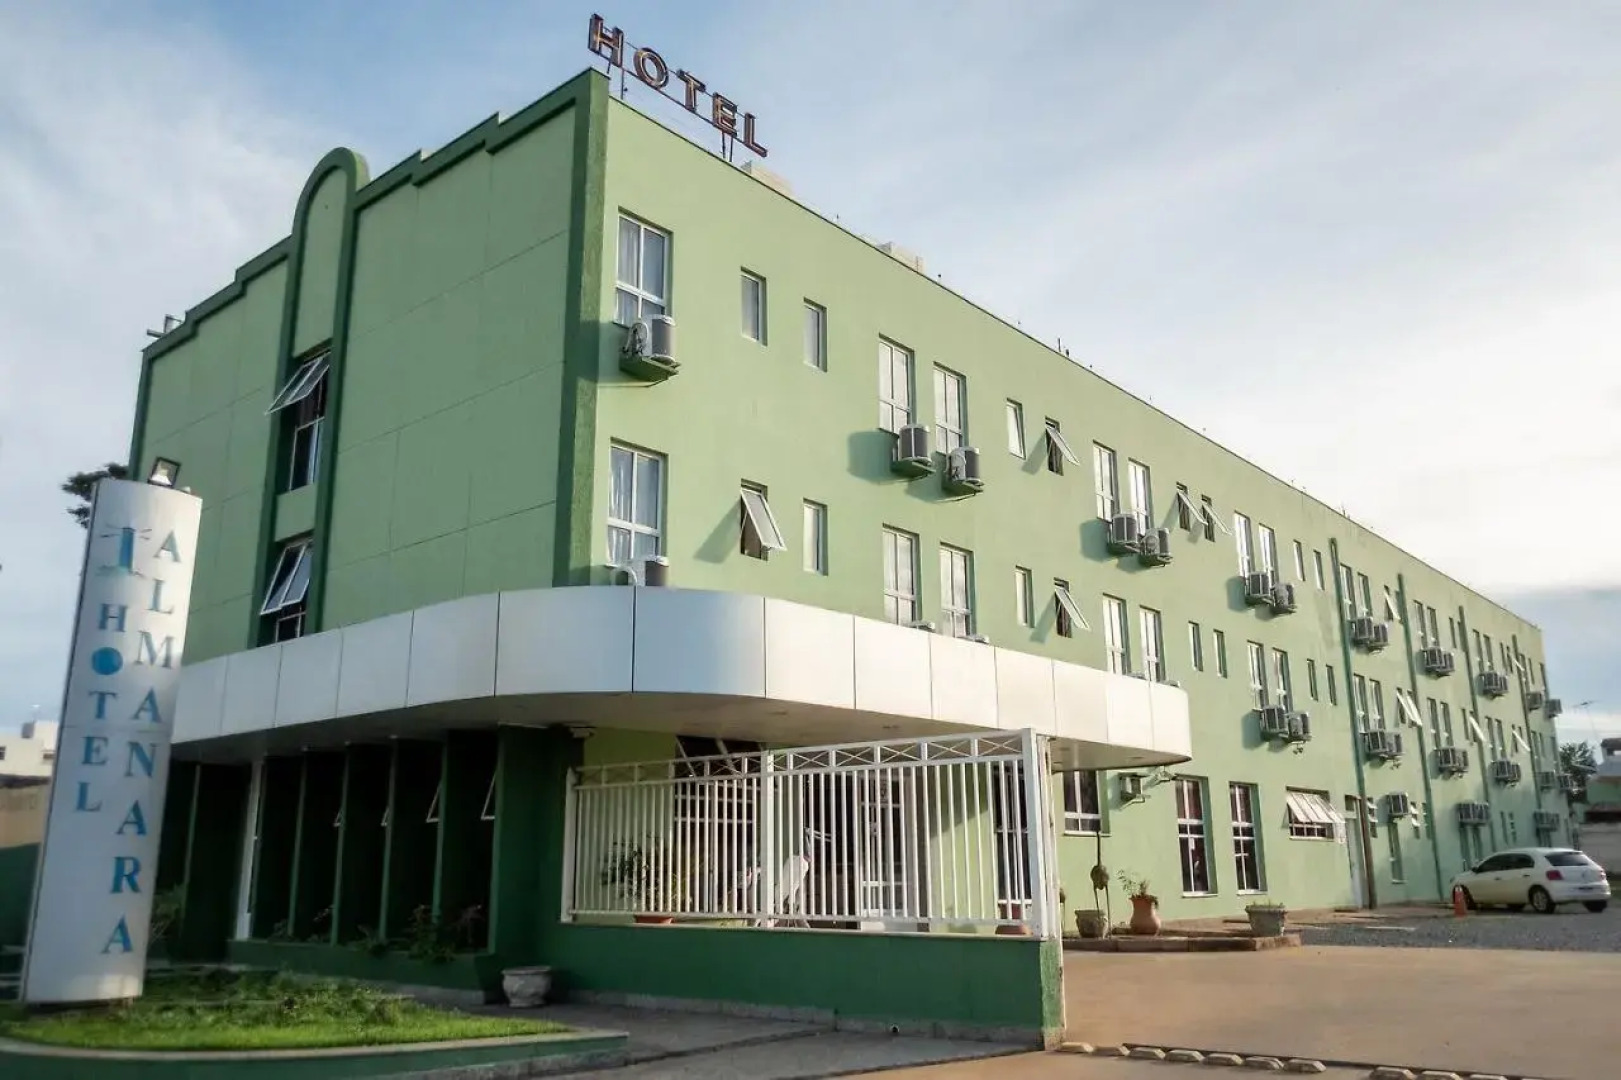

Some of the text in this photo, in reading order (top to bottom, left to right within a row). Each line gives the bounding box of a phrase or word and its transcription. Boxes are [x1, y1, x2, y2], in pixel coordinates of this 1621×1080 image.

[588, 13, 768, 158] HOTEL
[75, 601, 126, 813] HOTEL
[102, 530, 182, 955] ALMANARA
